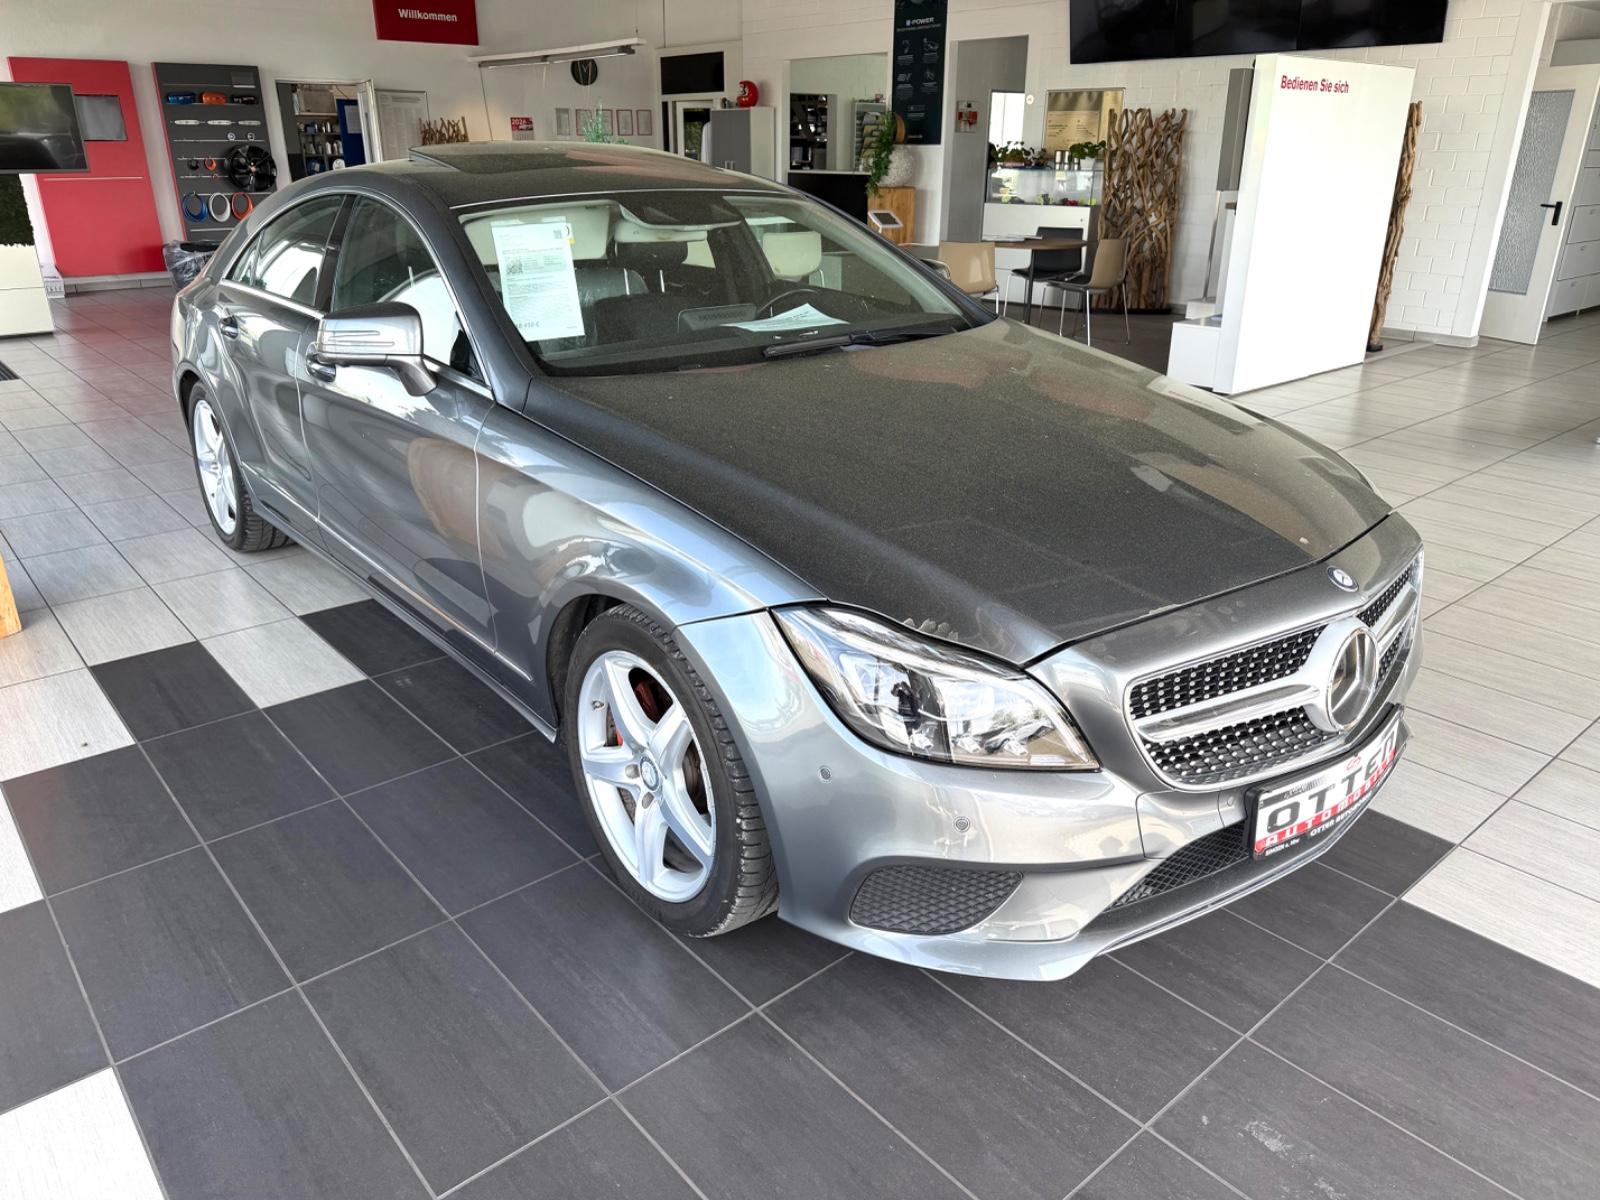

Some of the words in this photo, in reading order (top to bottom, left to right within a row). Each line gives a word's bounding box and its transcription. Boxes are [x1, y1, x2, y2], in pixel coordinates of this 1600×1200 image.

[398, 8, 458, 22] Willkommen
[1281, 75, 1318, 91] Bedienen
[1319, 78, 1333, 92] Sie
[1334, 80, 1349, 93] sich
